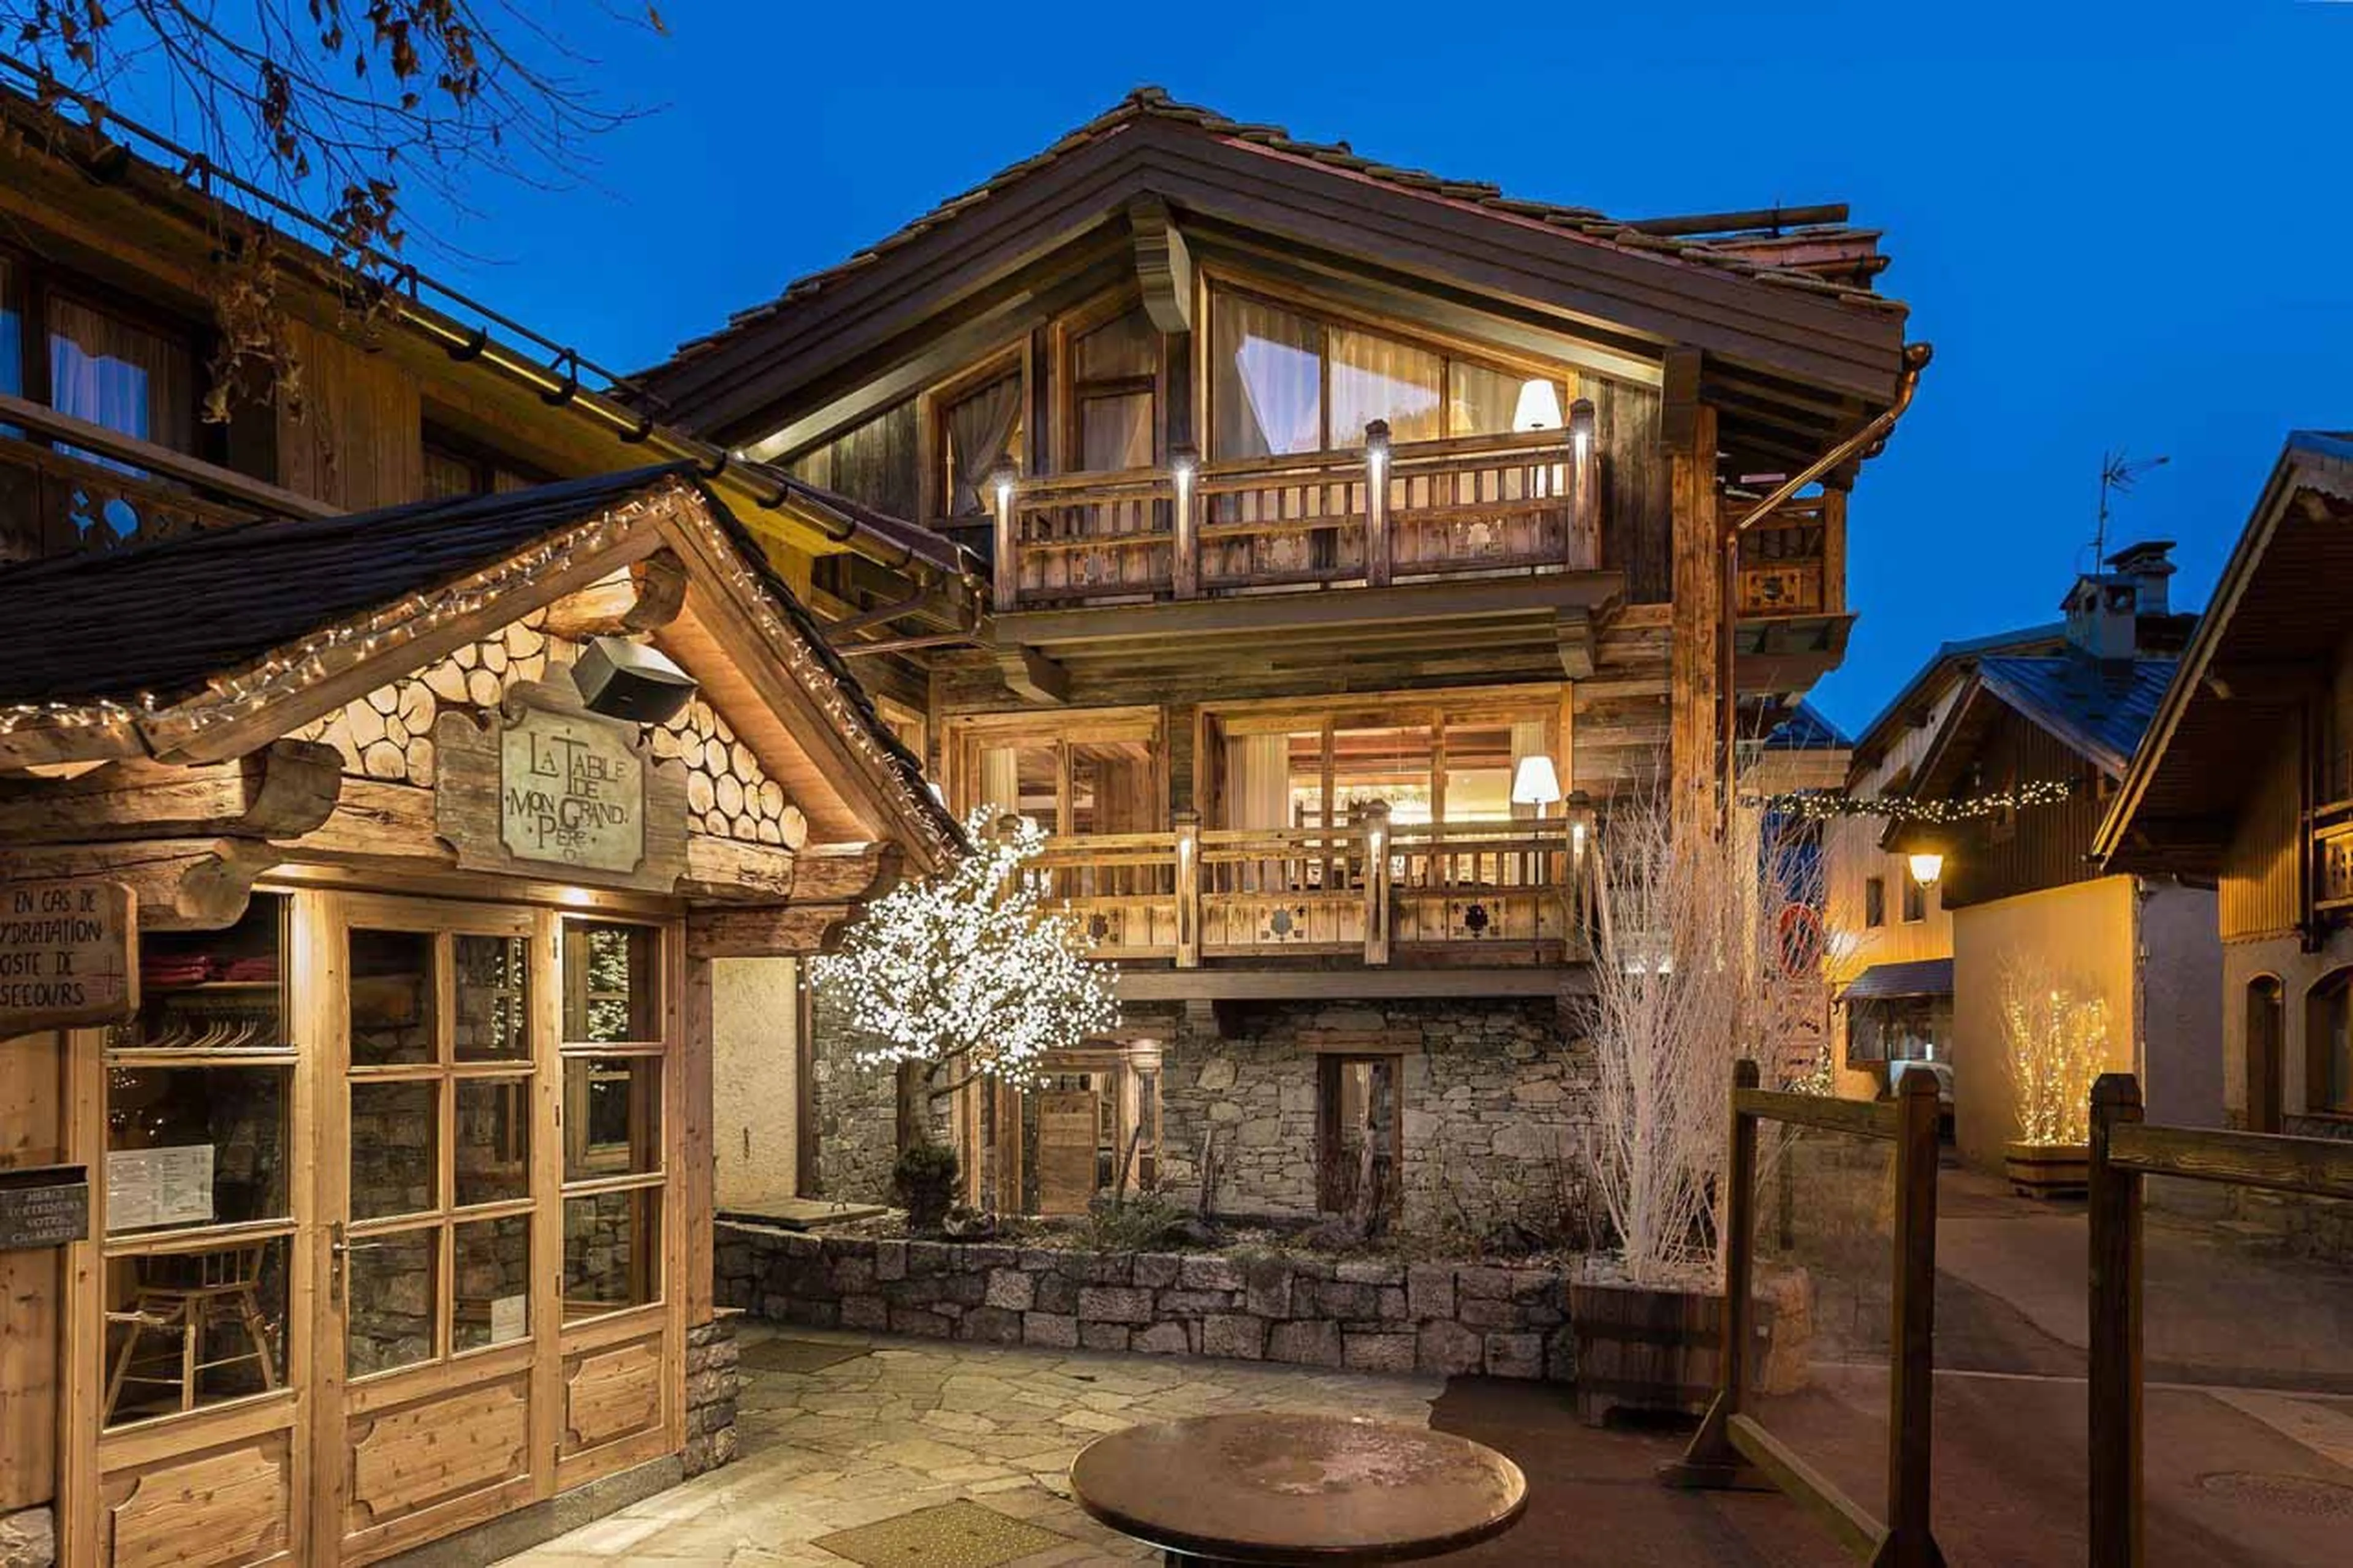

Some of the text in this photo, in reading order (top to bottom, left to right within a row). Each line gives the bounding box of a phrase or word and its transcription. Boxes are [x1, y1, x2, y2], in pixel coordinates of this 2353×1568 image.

[529, 732, 626, 794] LA TABLE
[574, 777, 599, 799] DE
[510, 788, 555, 817] MON
[14, 889, 96, 913] EN CAS DE
[56, 951, 74, 976] DE
[0, 983, 85, 1007] SECOURS
